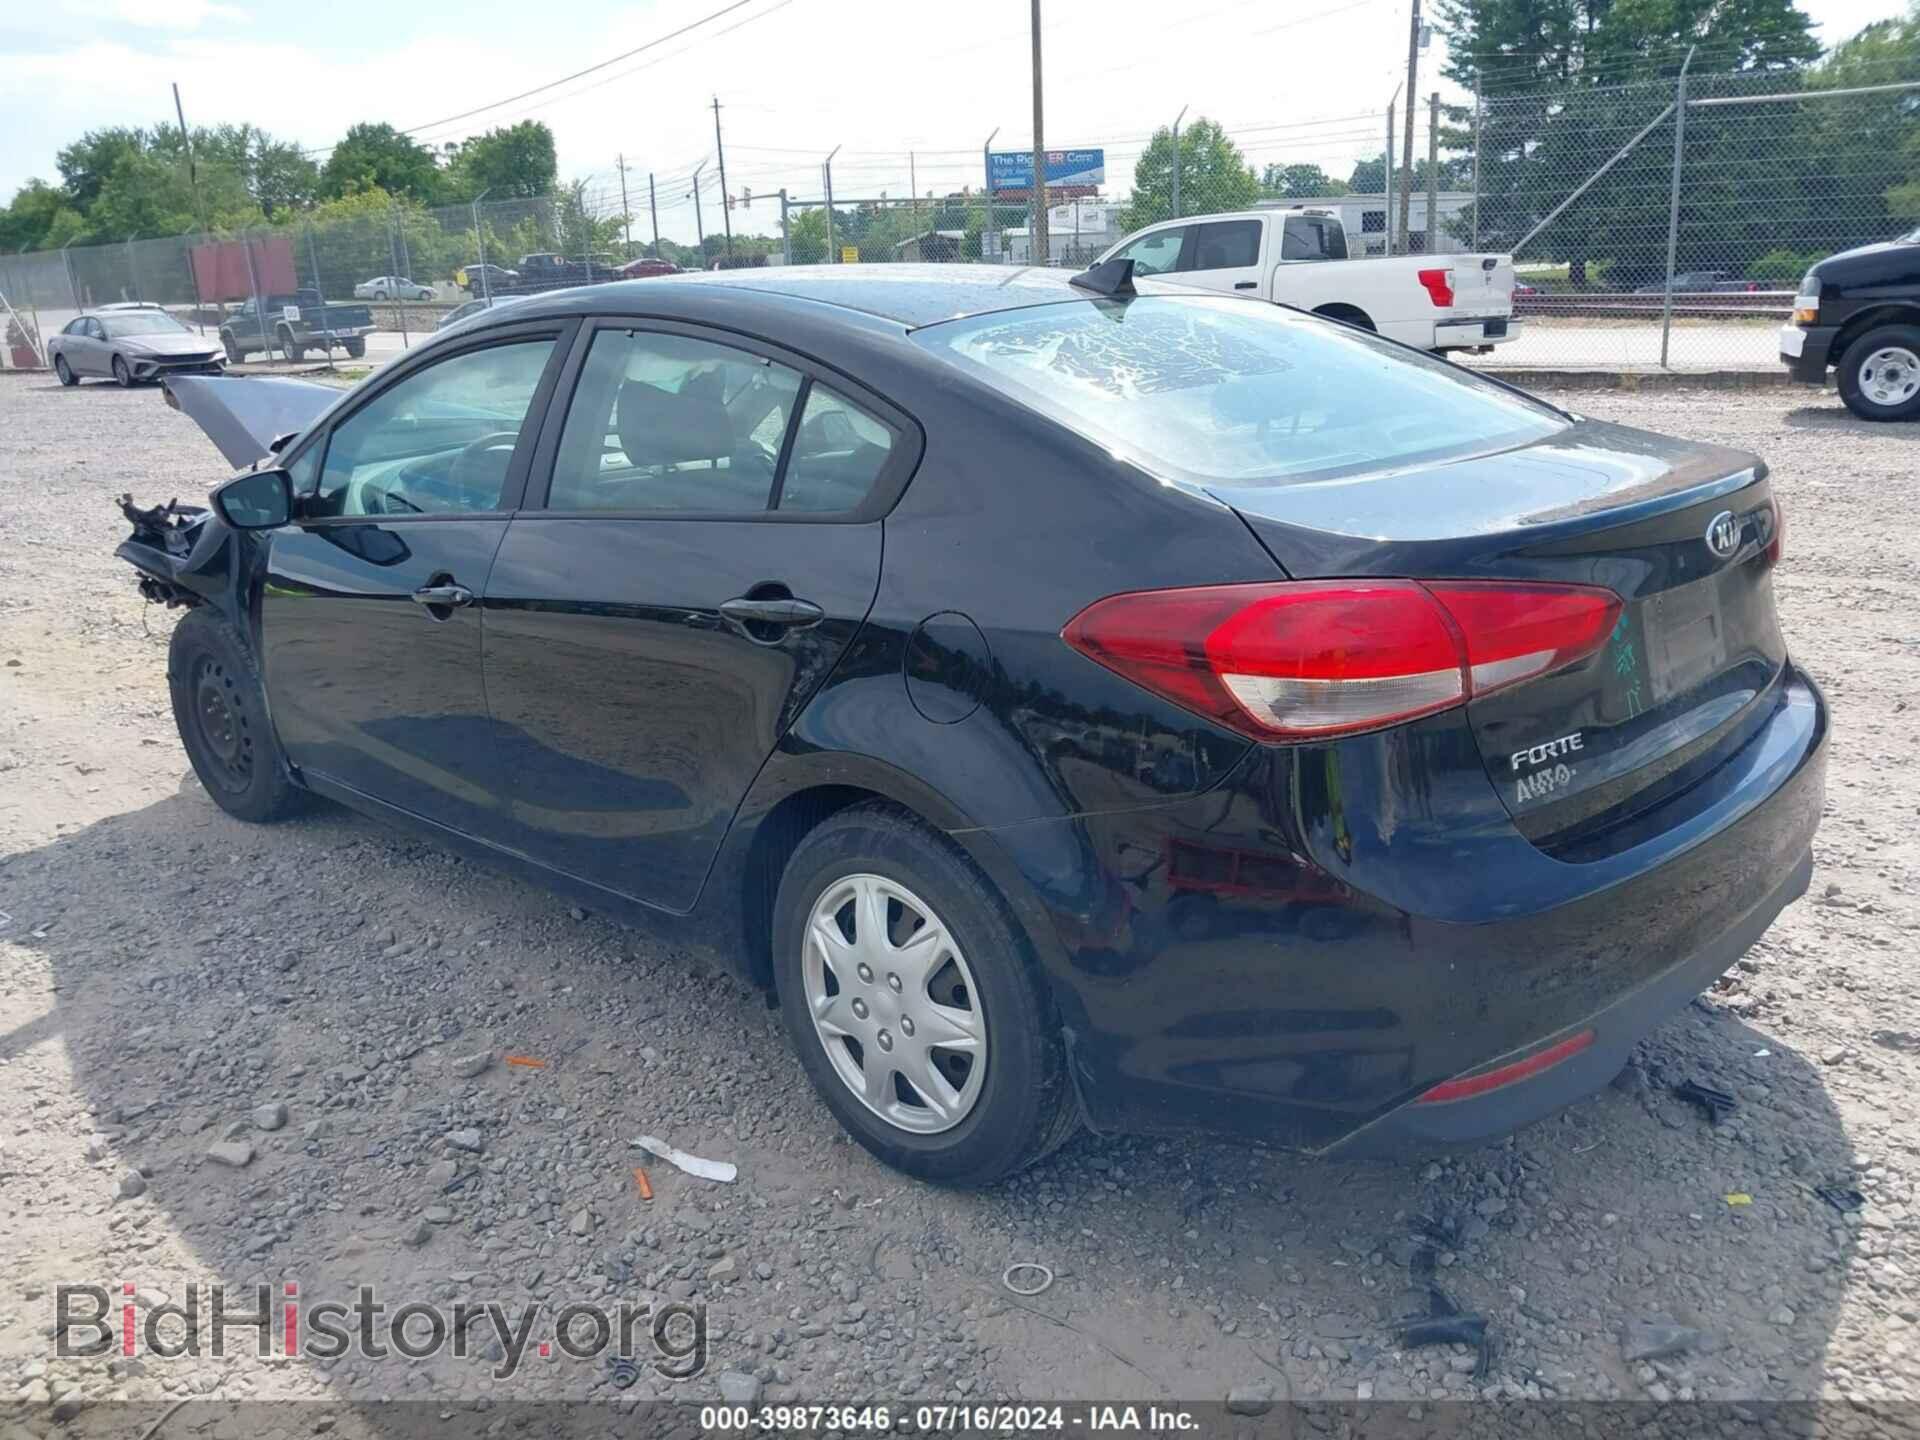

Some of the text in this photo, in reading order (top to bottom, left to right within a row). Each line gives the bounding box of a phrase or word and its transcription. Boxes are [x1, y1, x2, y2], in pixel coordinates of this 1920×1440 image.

[992, 154, 1013, 166] The
[1015, 153, 1035, 168] Rig
[1048, 152, 1064, 163] ER
[1511, 732, 1584, 770] FORTE
